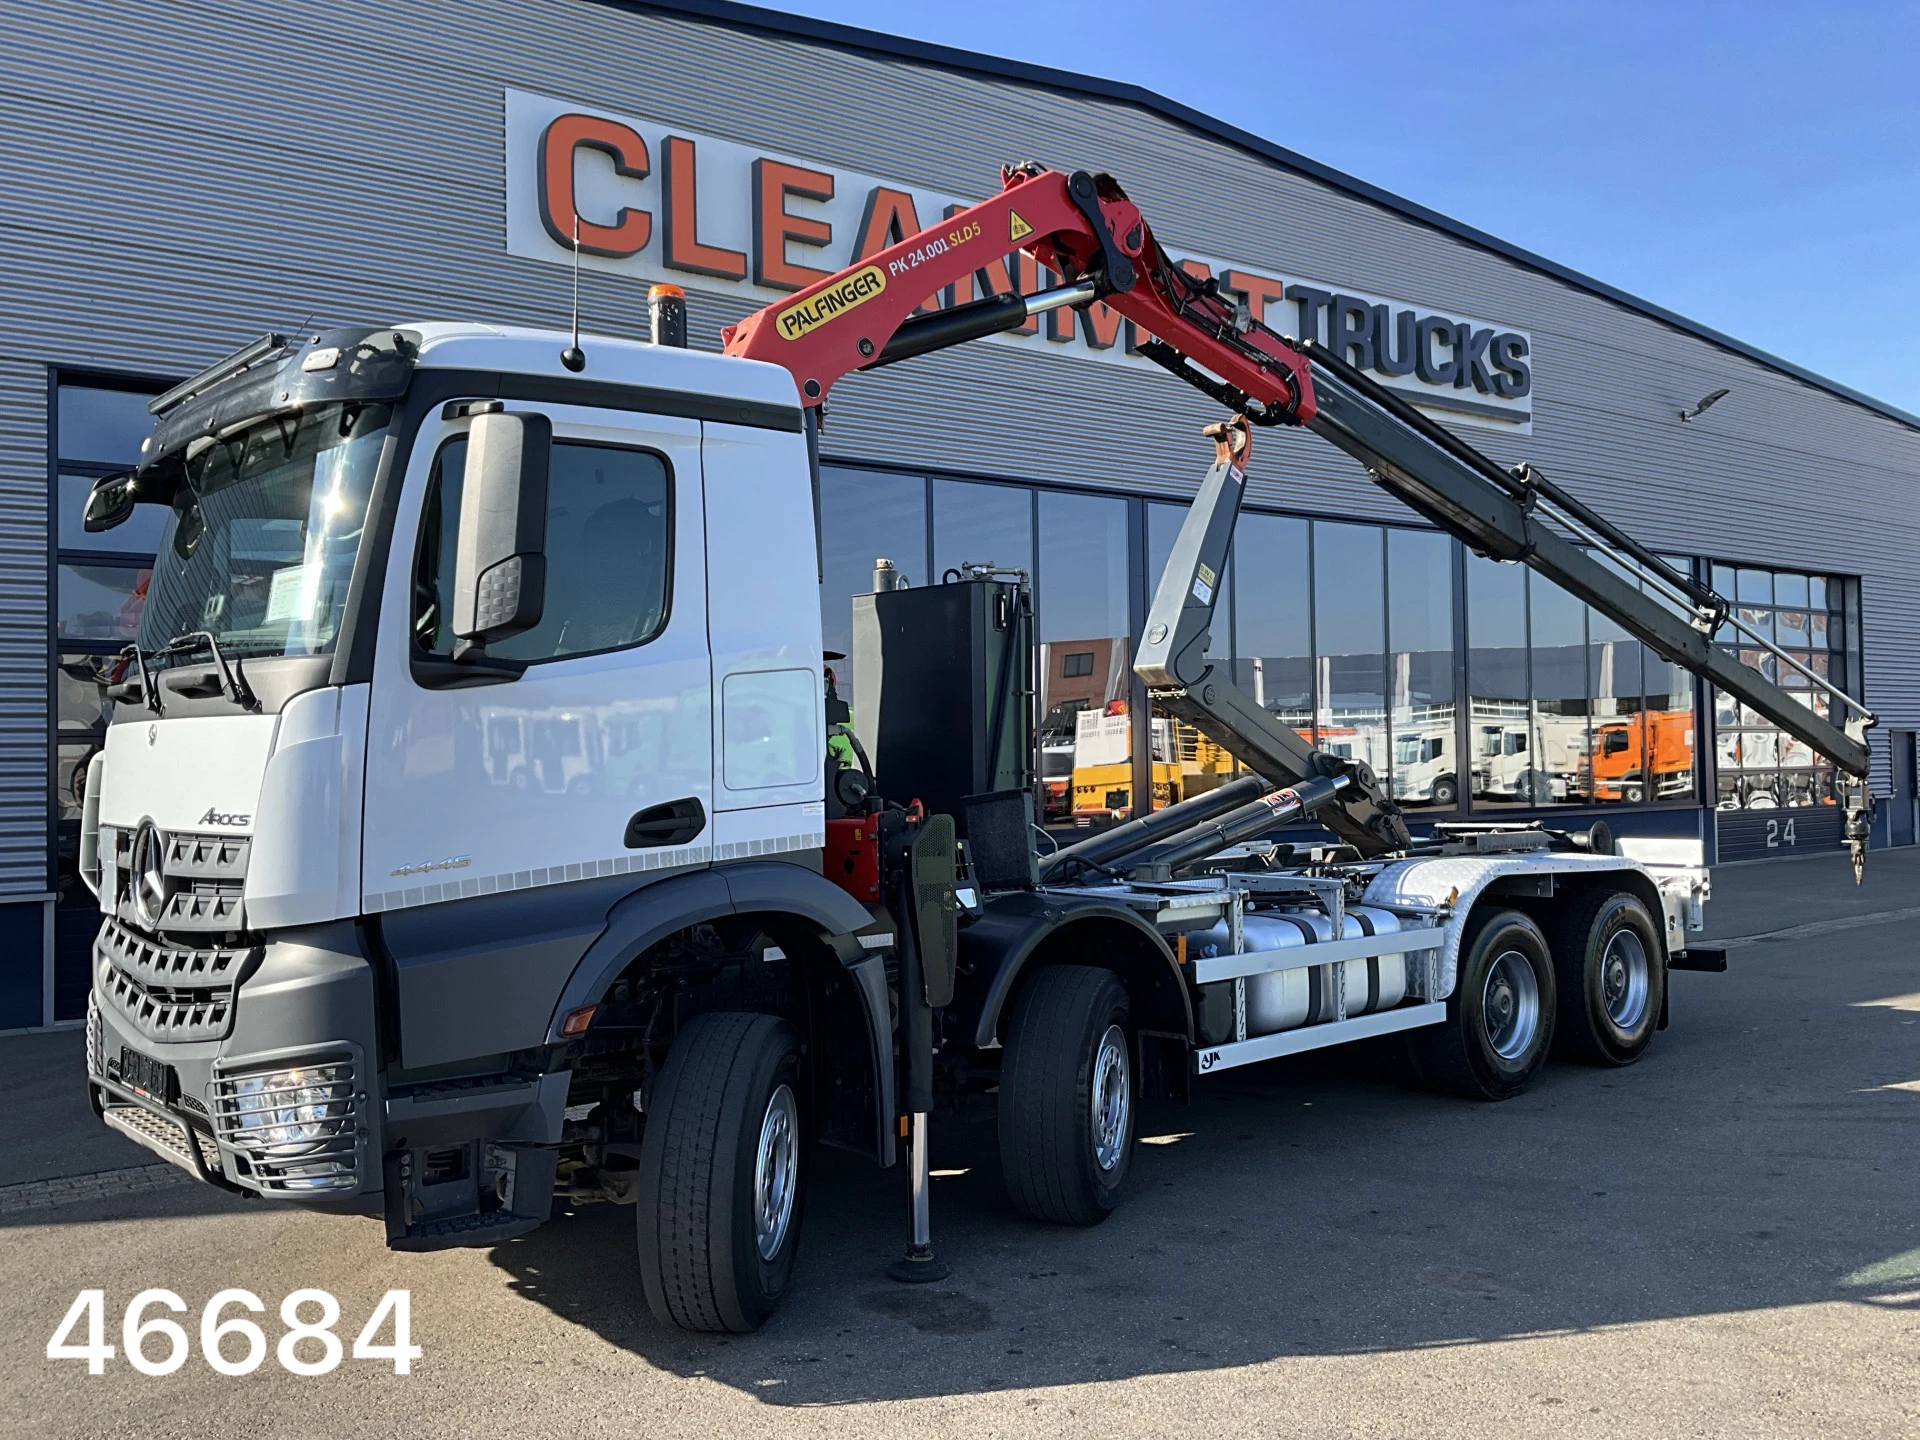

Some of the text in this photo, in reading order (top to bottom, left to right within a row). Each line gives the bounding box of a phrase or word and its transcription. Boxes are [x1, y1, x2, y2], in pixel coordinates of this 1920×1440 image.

[537, 113, 1531, 400] CLEANT TRUCKS
[888, 257, 910, 277] PK
[908, 237, 950, 268] 24.001
[782, 271, 882, 336] PALFINGER
[1766, 817, 1796, 848] 24
[1201, 1050, 1221, 1070] AJK
